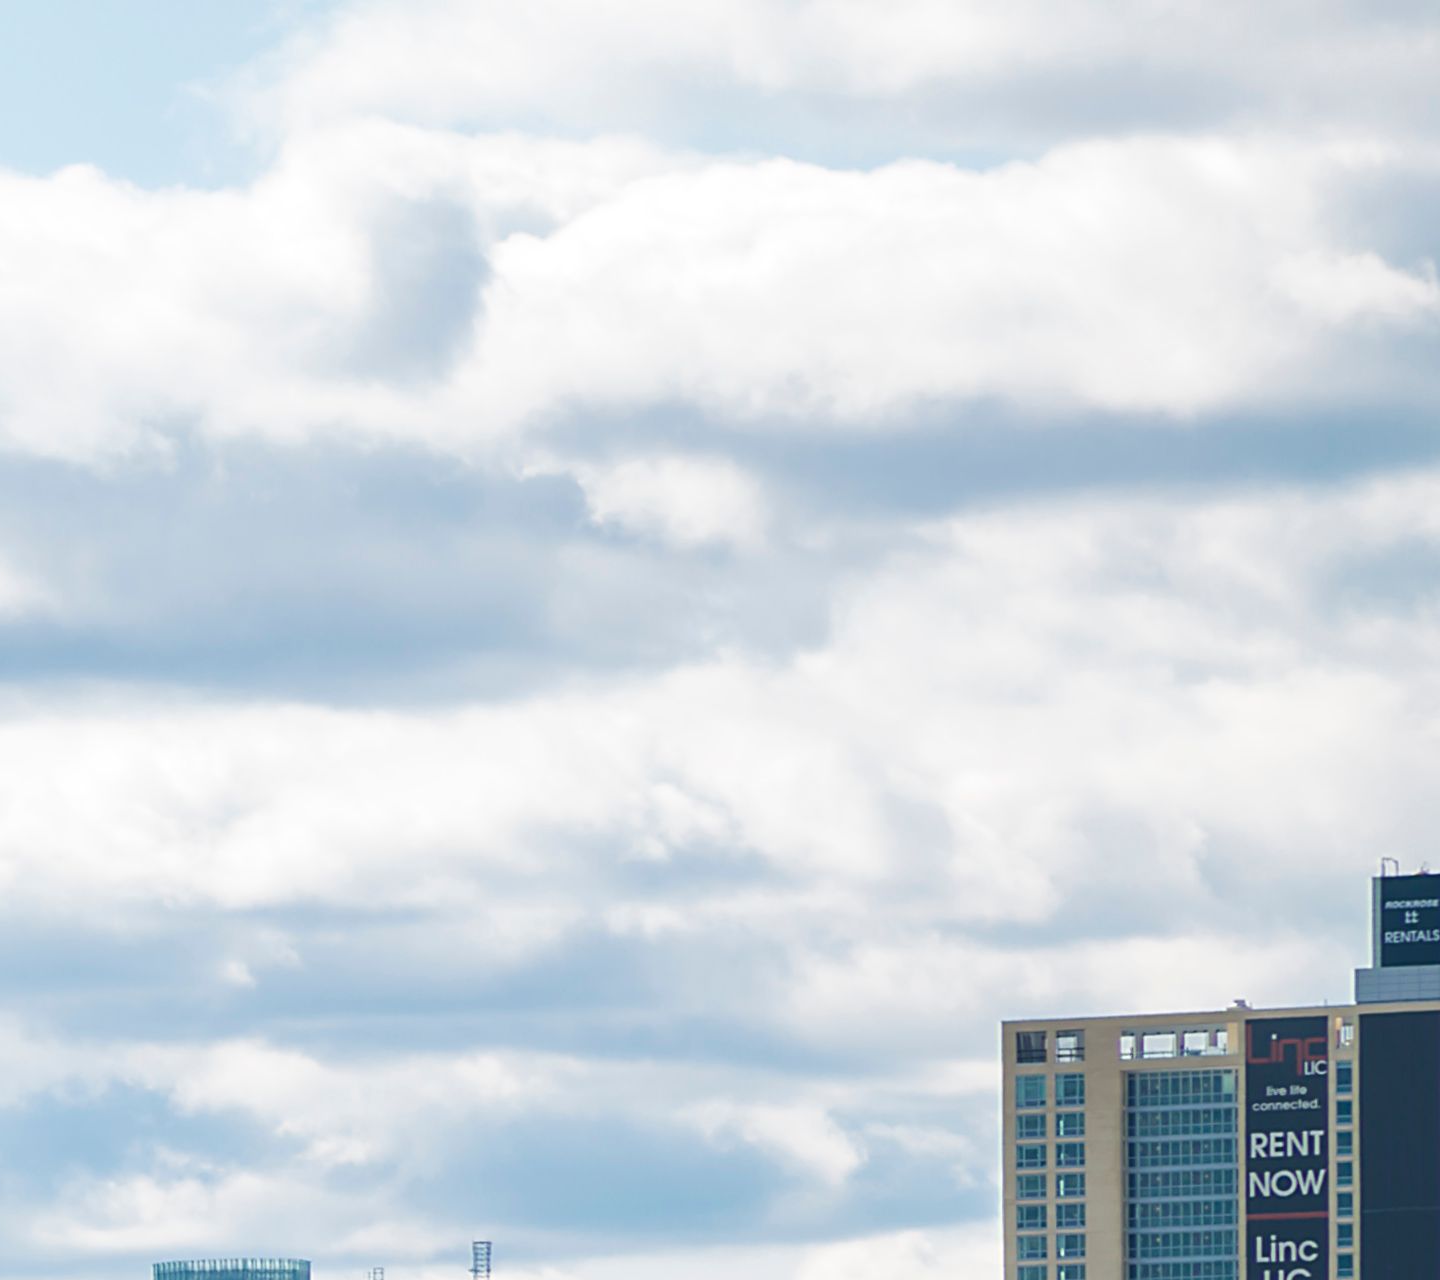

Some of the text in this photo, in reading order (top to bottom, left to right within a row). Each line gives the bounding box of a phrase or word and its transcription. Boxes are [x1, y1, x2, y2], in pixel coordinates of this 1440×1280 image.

[1303, 1060, 1328, 1076] LIC
[1250, 1130, 1324, 1158] RENT
[1248, 1169, 1327, 1197] NOW
[1255, 1235, 1319, 1263] Linc
